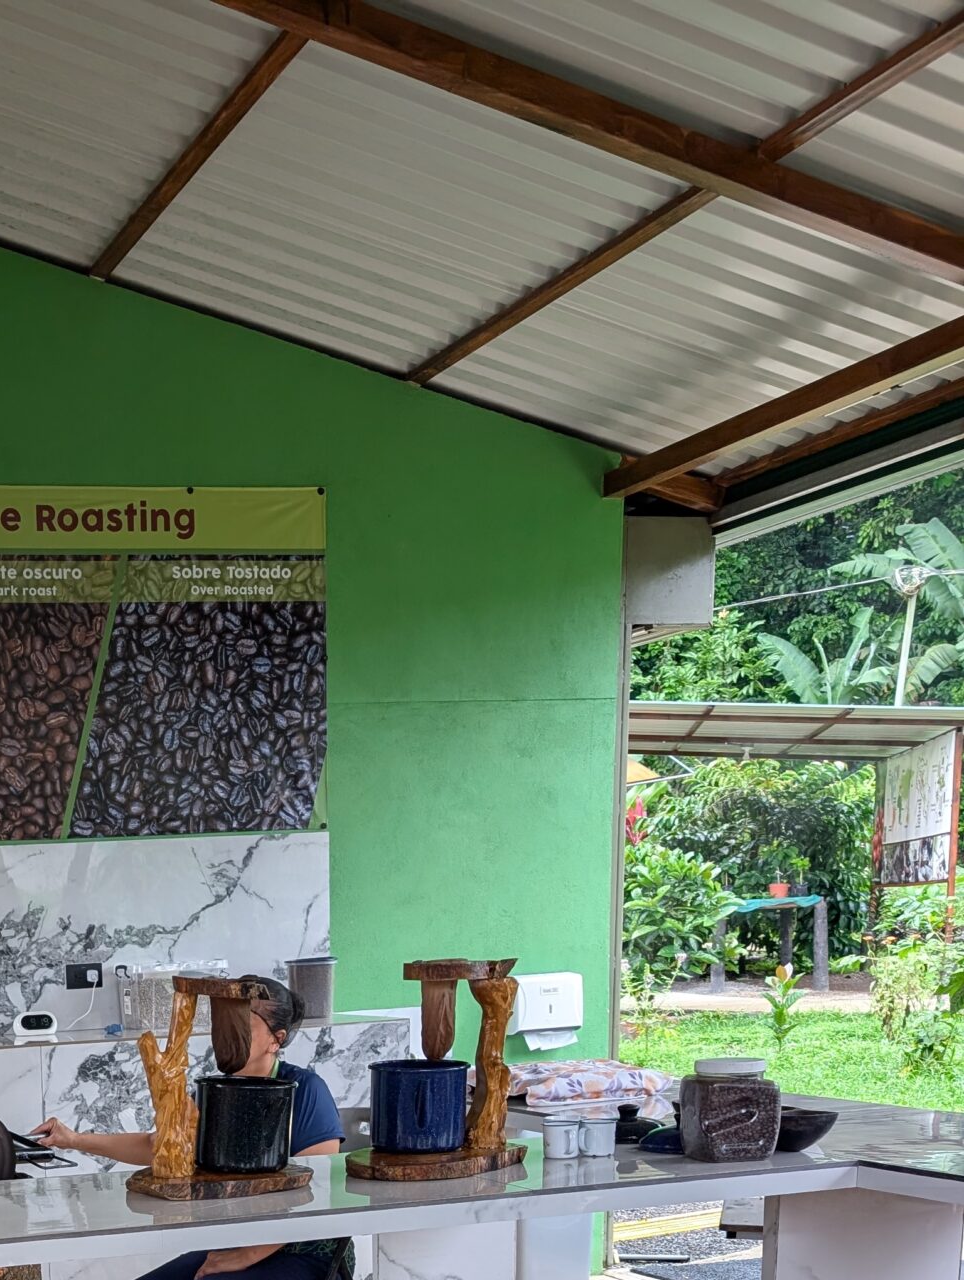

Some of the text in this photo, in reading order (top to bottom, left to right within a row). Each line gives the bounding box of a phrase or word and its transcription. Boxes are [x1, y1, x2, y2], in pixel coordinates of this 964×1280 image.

[35, 500, 196, 540] Roasting
[22, 567, 82, 580] oscuro
[172, 565, 292, 579] Sobre Tostado
[22, 586, 57, 597] roast
[191, 585, 274, 595] Over Roasted
